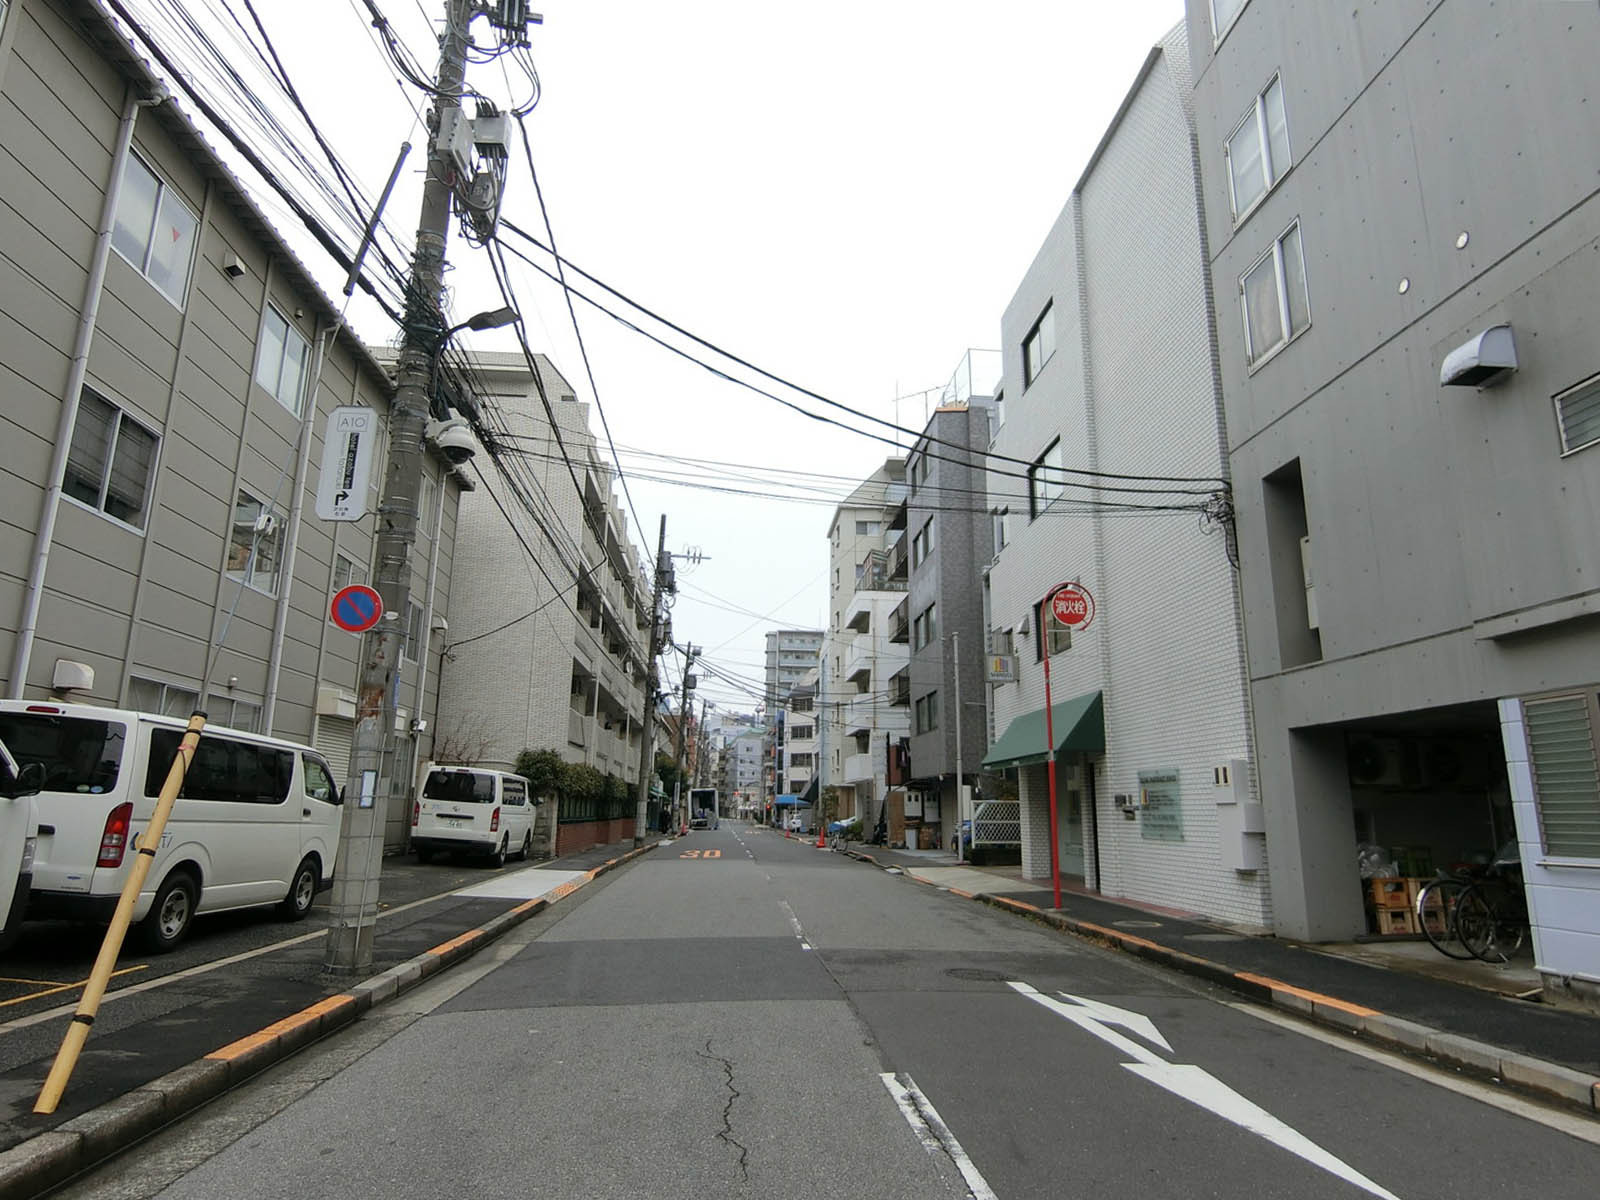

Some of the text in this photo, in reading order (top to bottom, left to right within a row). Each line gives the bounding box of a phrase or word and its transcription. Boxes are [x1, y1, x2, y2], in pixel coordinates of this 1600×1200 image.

[349, 433, 360, 452] hotel
[1055, 600, 1085, 614] 消火栓
[680, 849, 721, 859] 30
